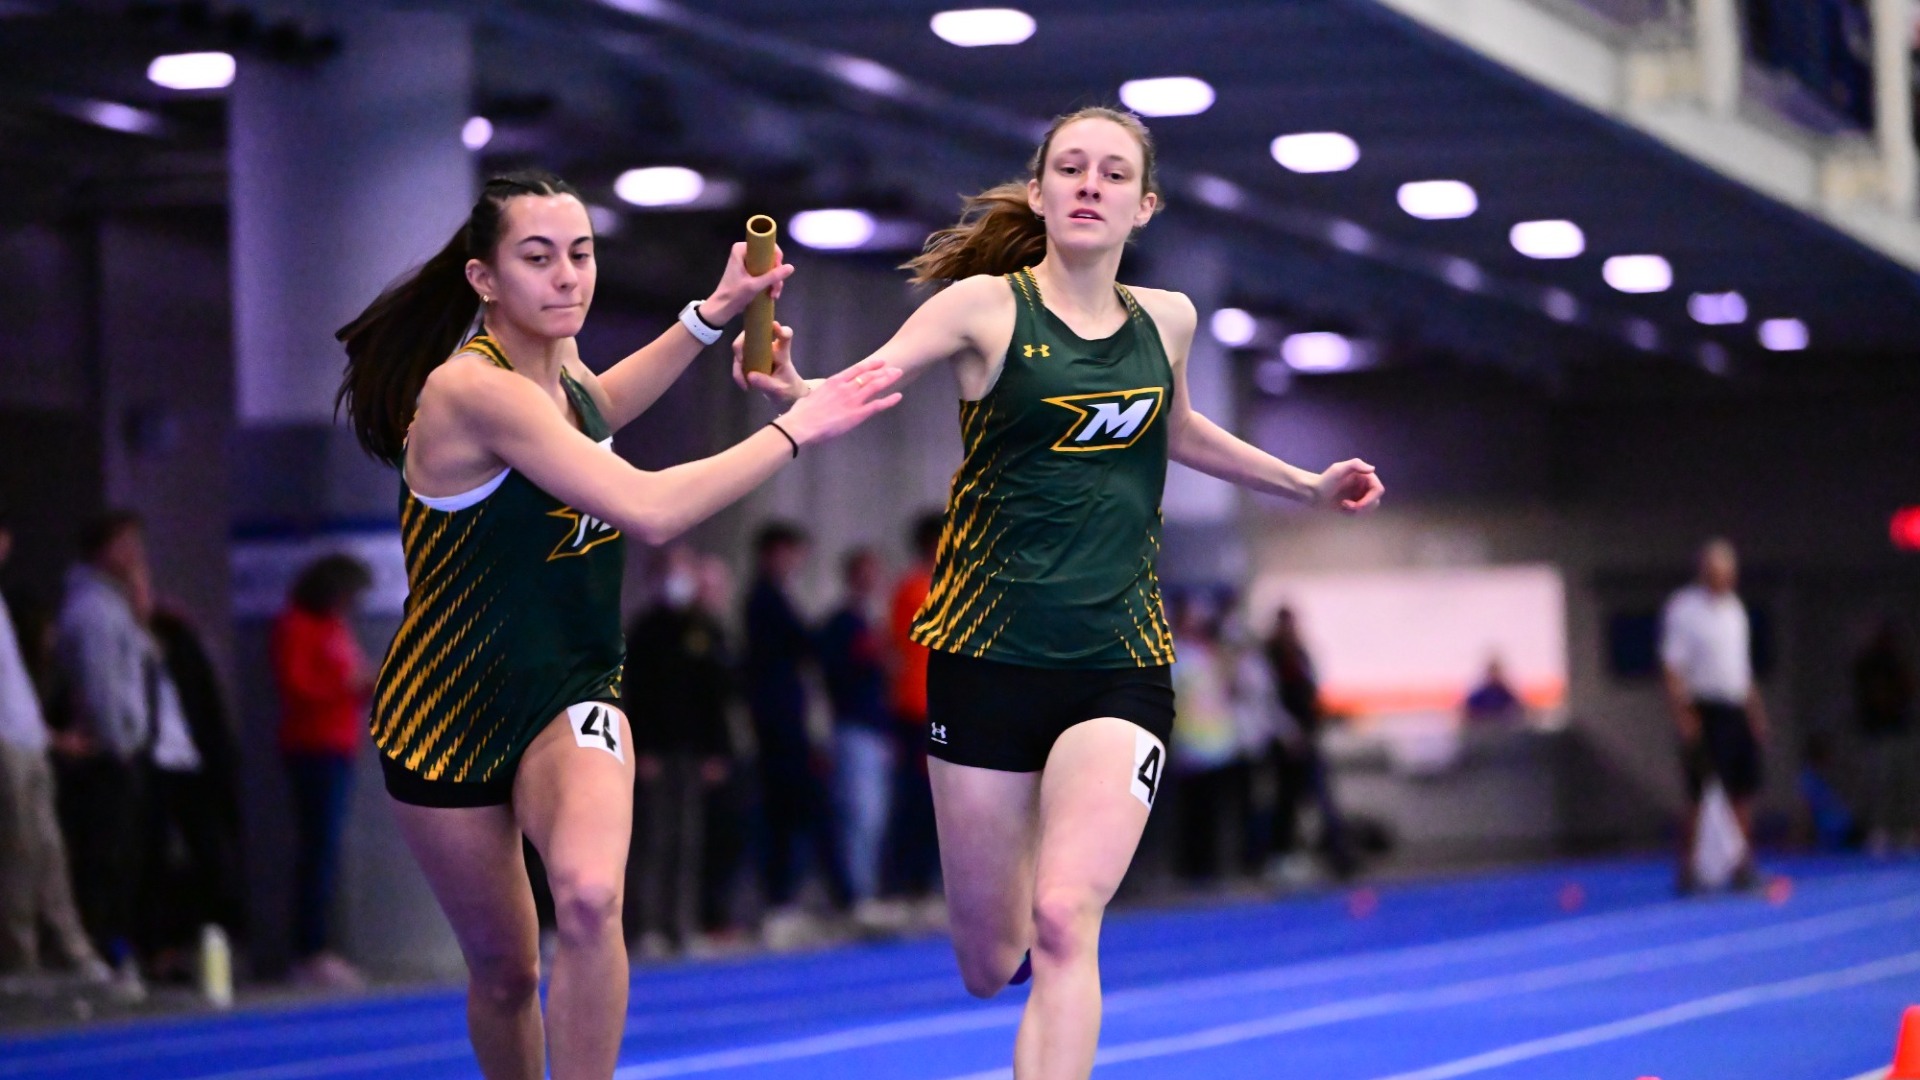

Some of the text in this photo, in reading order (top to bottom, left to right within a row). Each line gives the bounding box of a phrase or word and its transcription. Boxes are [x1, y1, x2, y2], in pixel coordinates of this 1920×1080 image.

[1074, 398, 1154, 442] M
[580, 705, 617, 753] 4
[1137, 744, 1161, 804] 4
